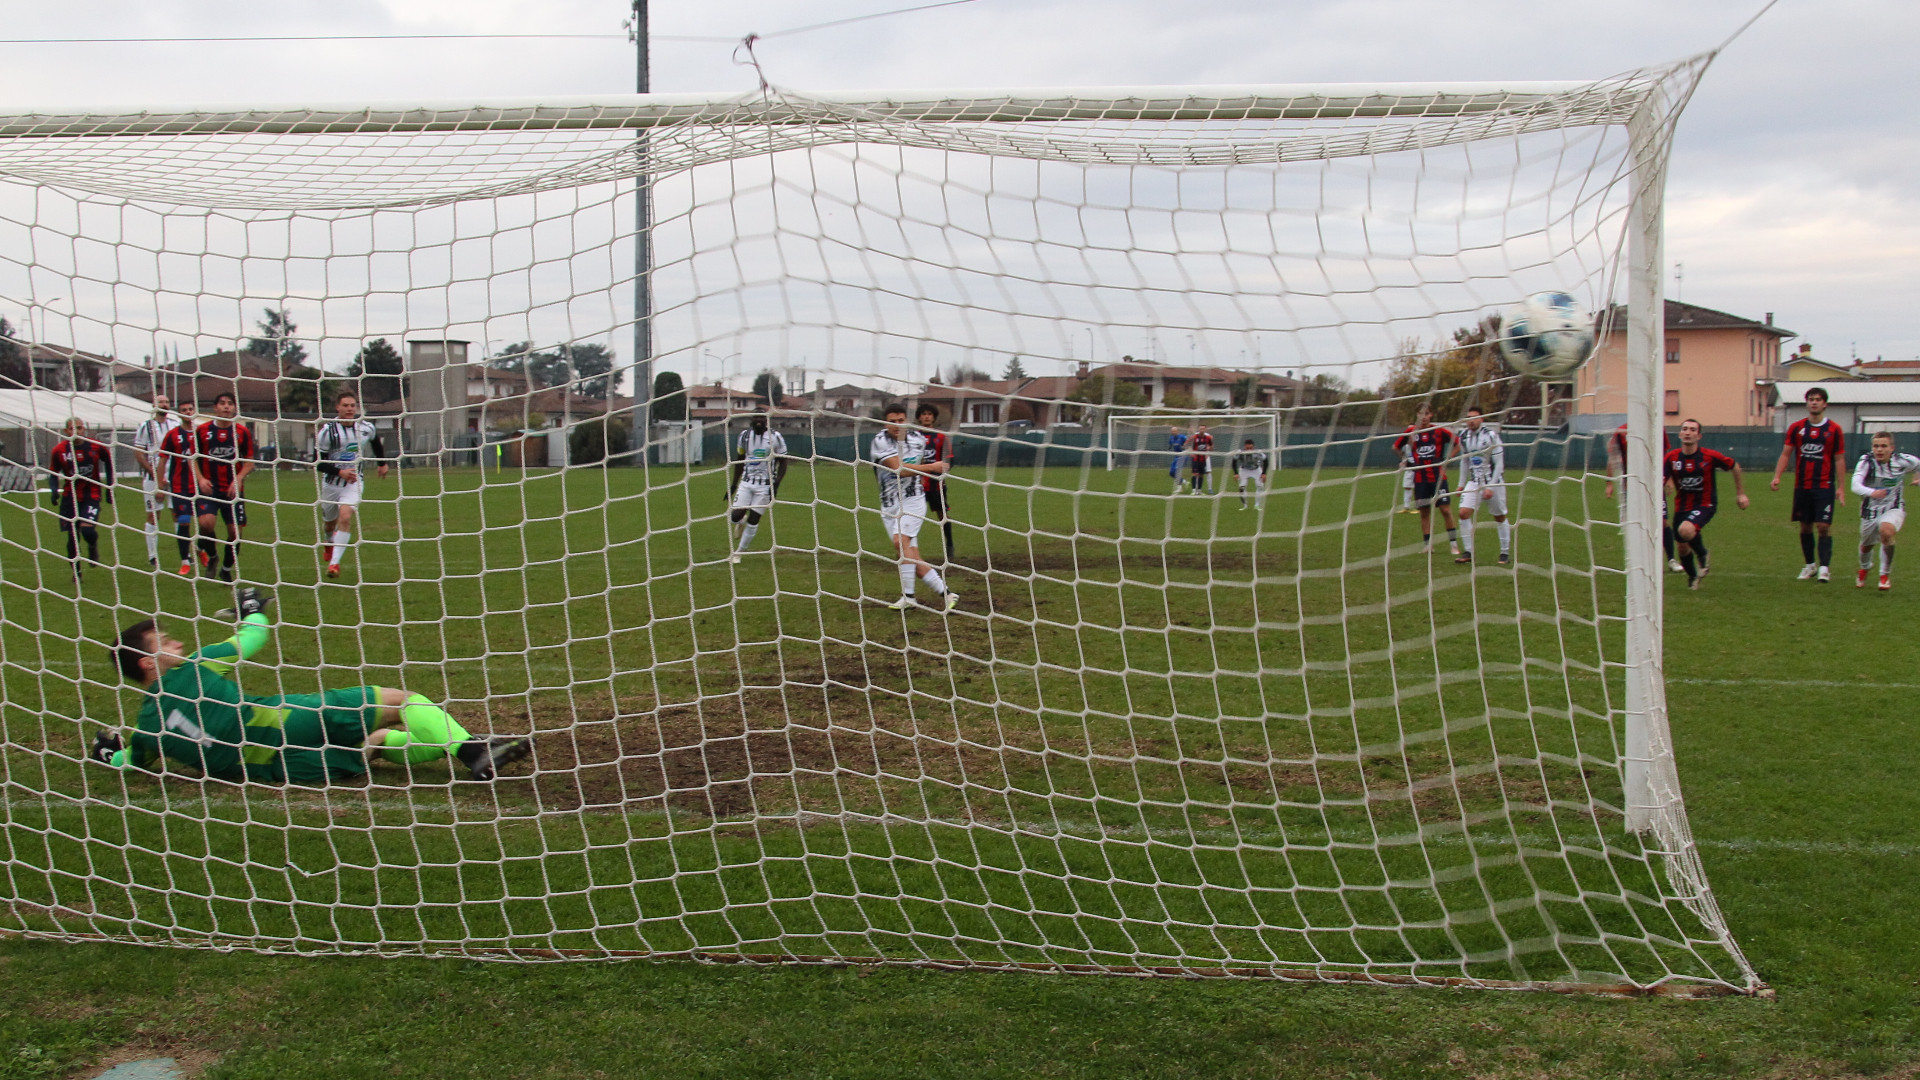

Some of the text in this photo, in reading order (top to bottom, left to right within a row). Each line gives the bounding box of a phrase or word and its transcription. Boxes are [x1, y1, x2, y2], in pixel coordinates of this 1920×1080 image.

[205, 431, 213, 440] 5
[1798, 427, 1806, 436] 4
[177, 434, 184, 443] 3
[1672, 460, 1682, 471] 19
[87, 505, 98, 515] 14
[1824, 504, 1831, 513] 4
[165, 708, 216, 748] 1
